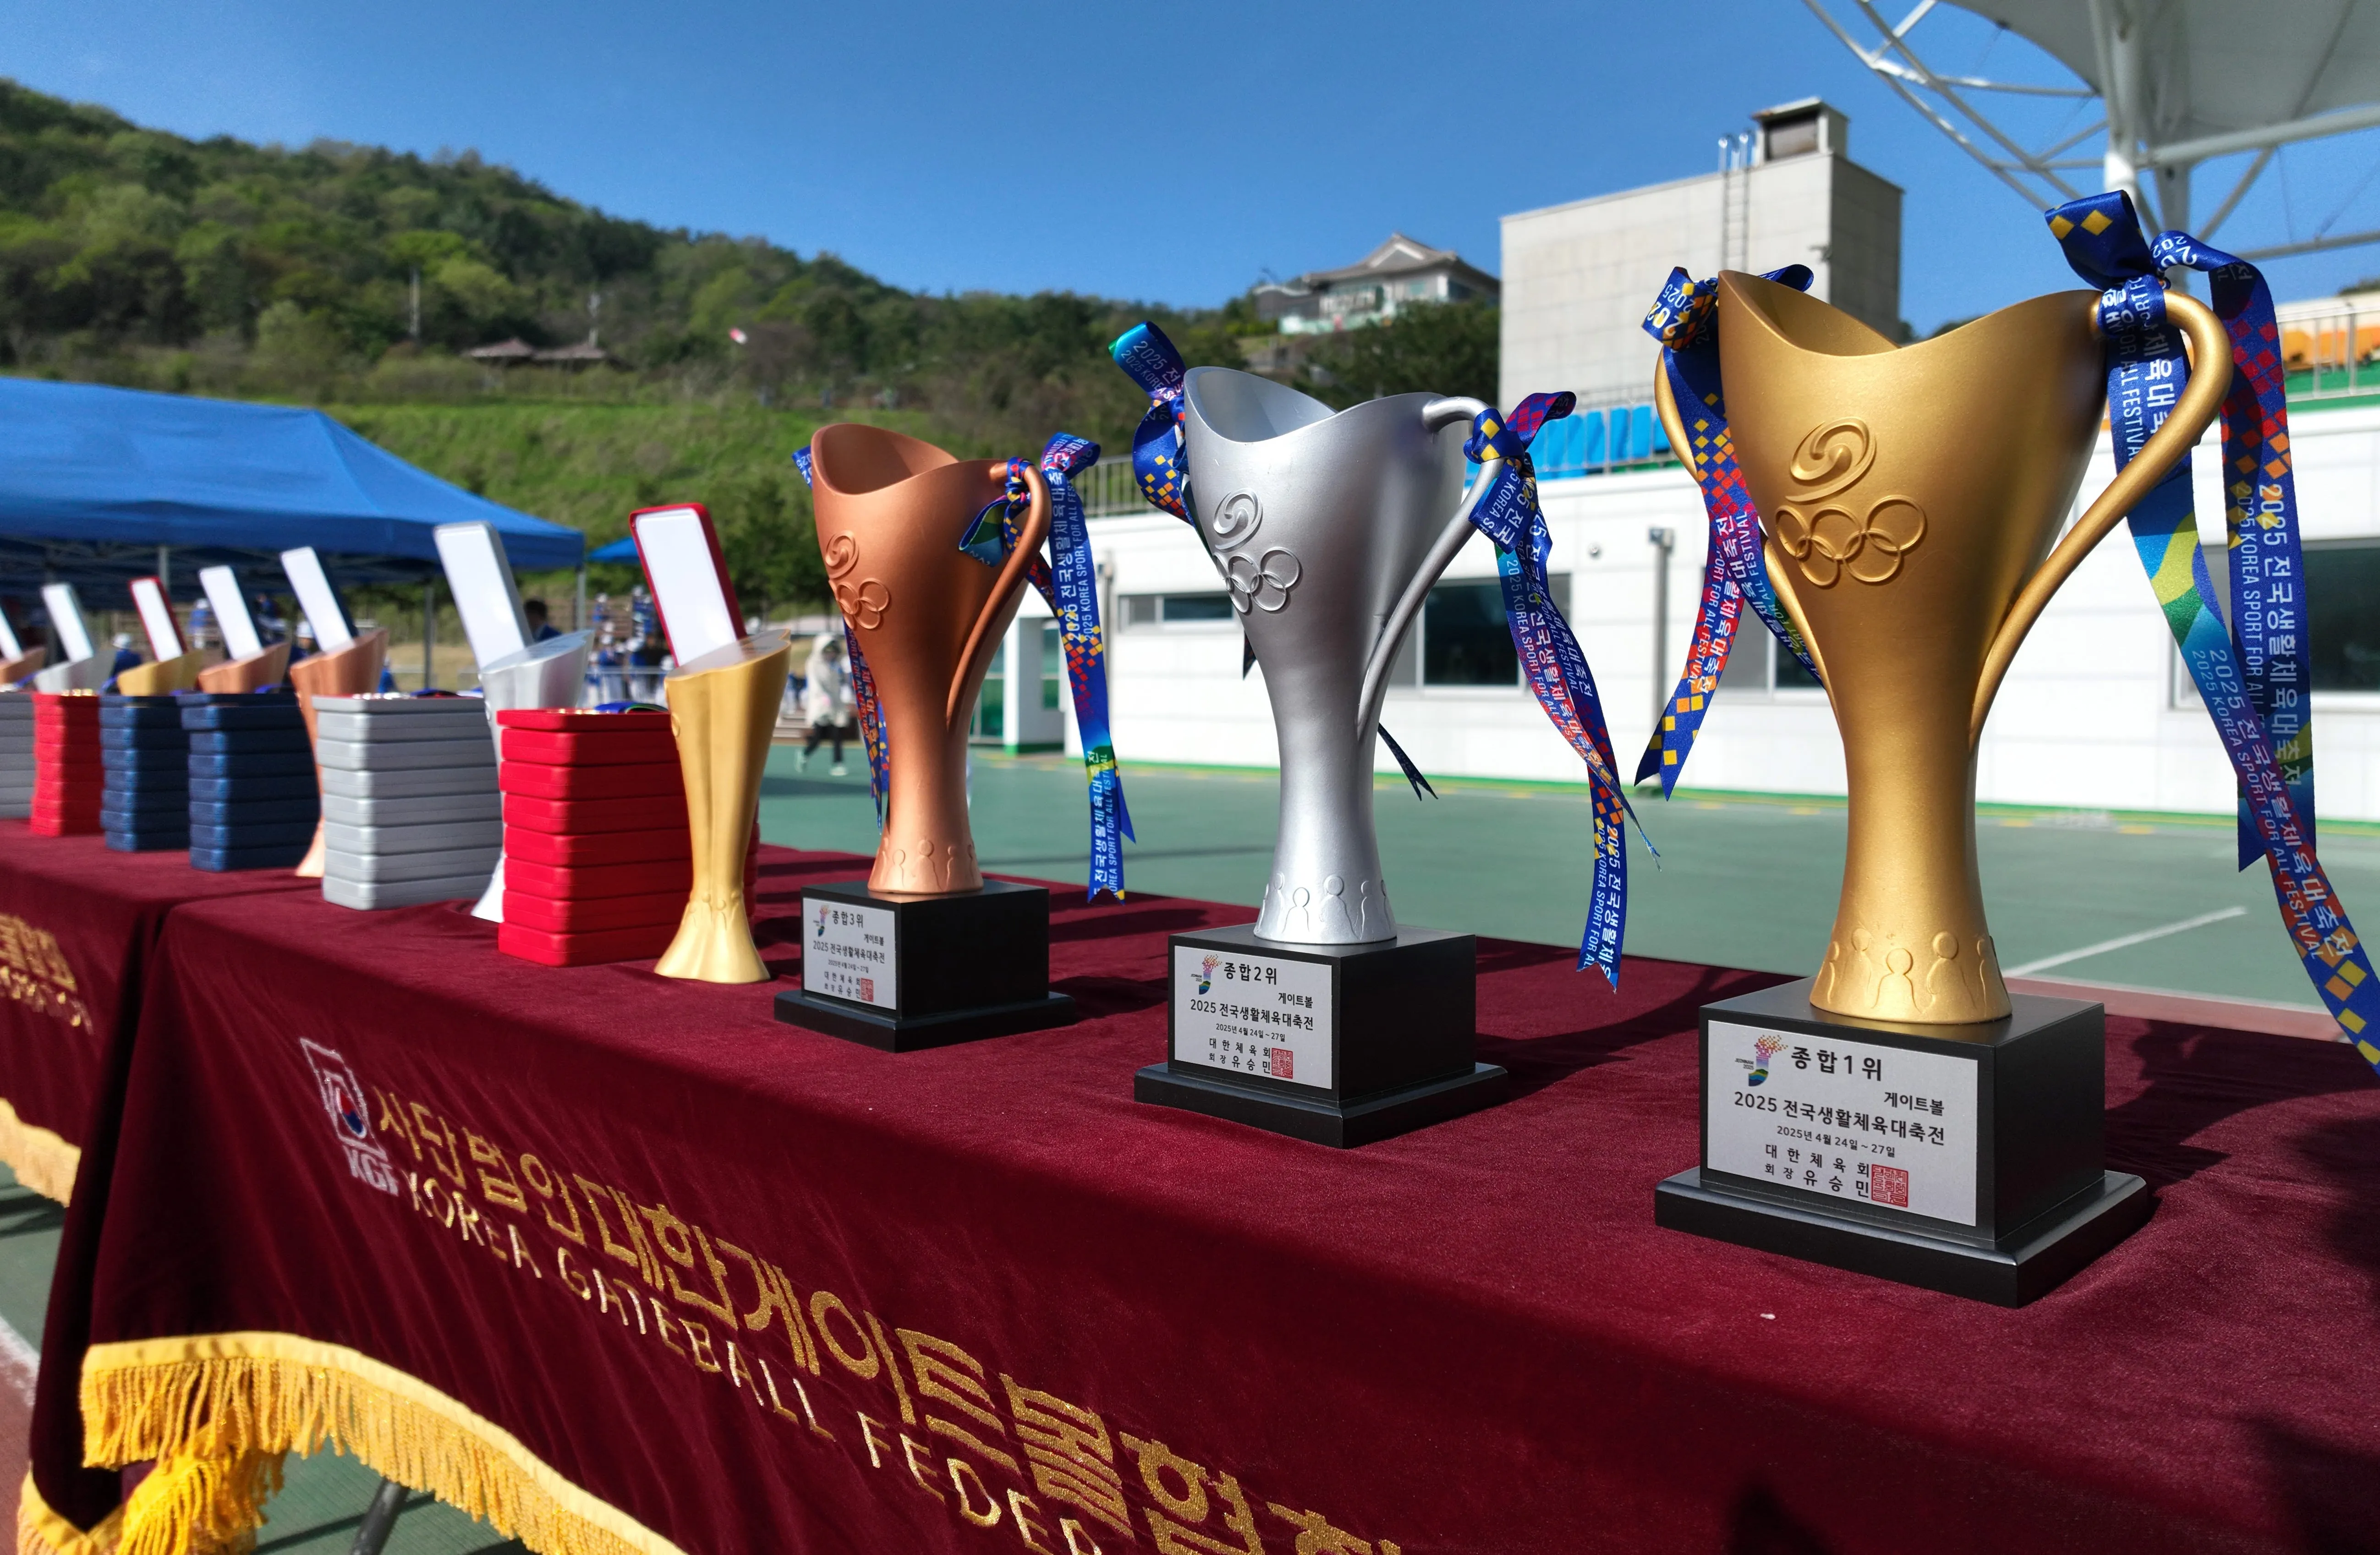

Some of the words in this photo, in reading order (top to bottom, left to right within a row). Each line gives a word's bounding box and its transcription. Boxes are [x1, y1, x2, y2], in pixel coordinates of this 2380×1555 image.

[1121, 350, 1145, 372] 2025
[1140, 369, 1167, 394] KOREA
[1133, 340, 1168, 370] 2025
[2122, 388, 2145, 462] FESTIVA
[1489, 482, 1517, 518] KOREA
[2259, 483, 2288, 546] 2025
[1070, 524, 1083, 542] FOR
[1735, 511, 1759, 576] FESTIVAL
[1074, 545, 1088, 577] SPORT
[1507, 559, 1522, 591] 2025
[2239, 533, 2260, 585] KOREA
[1079, 579, 1091, 612] KOREA
[1708, 583, 1722, 608] FOR
[1755, 580, 1771, 600] ALL
[1513, 595, 1530, 634] KOREA
[1703, 608, 1716, 629] ALL
[2243, 591, 2263, 641] SPORT
[1522, 637, 1541, 673] SPORT
[1556, 642, 1578, 690] FESTIVAL
[1687, 631, 1711, 684] FESTIVAL
[2246, 647, 2264, 677] FOR
[1535, 676, 1549, 698] FOR
[2192, 650, 2218, 691] 2025
[2211, 696, 2243, 747] KOREA
[2237, 752, 2268, 805] SPORT
[2260, 810, 2280, 841] FOR
[2273, 847, 2290, 875] ALL
[2283, 881, 2324, 959] FESTIVAL
[2209, 649, 2245, 710] 2025
[2237, 718, 2354, 955] 전국생활체육대축전
[1108, 835, 1117, 866] SPORT
[1607, 824, 1621, 869] 2025
[1597, 851, 1608, 889] KOREA
[1592, 891, 1605, 930] SPORT
[813, 940, 829, 952] 2025
[1587, 930, 1601, 953] FOR
[1223, 962, 1277, 985] 종합2위
[1190, 999, 1217, 1013] 2025
[1219, 1003, 1314, 1031] 전국생활체육대축전
[1278, 992, 1313, 1008] 게이트볼
[1216, 1024, 1237, 1034] 2025년
[1238, 1027, 1248, 1036] 4월
[1250, 1029, 1264, 1039] 24일
[1271, 1032, 1285, 1042] 27일
[1791, 1045, 1882, 1081] 종합1위
[1734, 1091, 1777, 1112] 2025
[1783, 1100, 1945, 1146] 전국생활체육대축전
[1884, 1091, 1945, 1117] 게이트볼
[1777, 1125, 1813, 1143] 2025년
[1815, 1133, 1832, 1146] 4월
[1834, 1137, 1859, 1151] 24일
[1871, 1142, 1896, 1158] 27일
[400, 1168, 542, 1279] KOREA
[557, 1246, 837, 1442] GATEBALL
